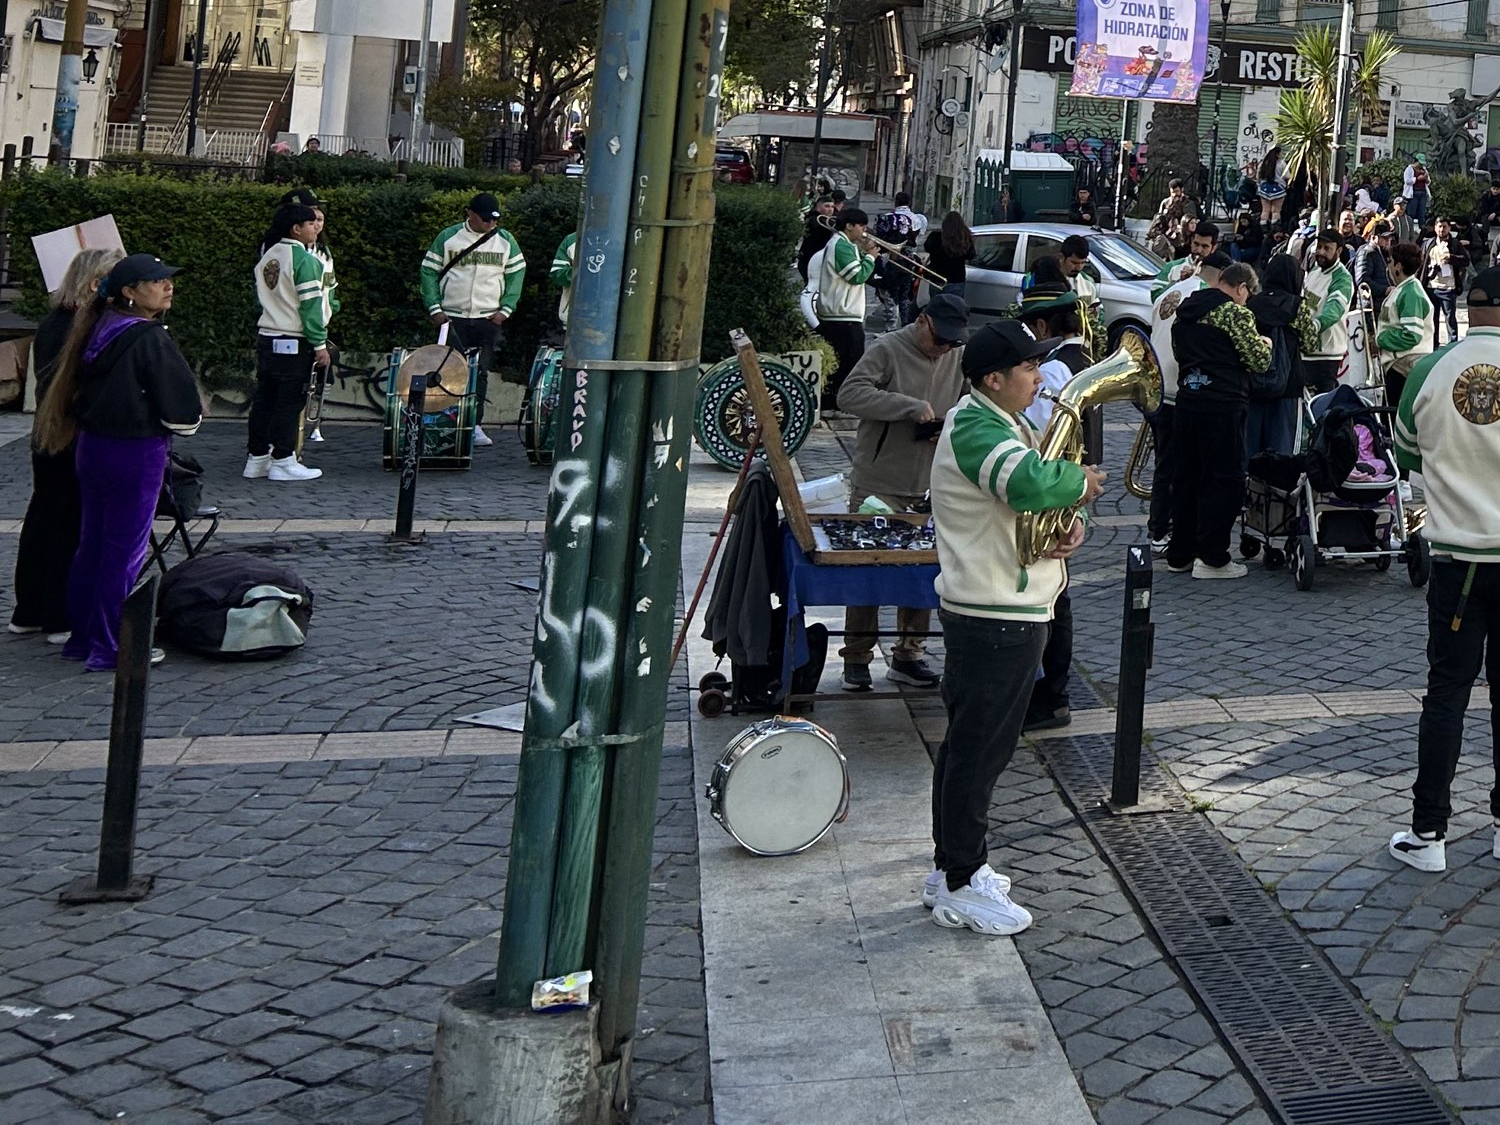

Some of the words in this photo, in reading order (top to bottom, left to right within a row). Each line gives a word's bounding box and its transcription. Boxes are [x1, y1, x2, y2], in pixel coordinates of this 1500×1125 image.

[1120, 2, 1156, 20] ZONA
[1159, 6, 1175, 21] DE
[1104, 19, 1189, 41] HIDRATACIÓN
